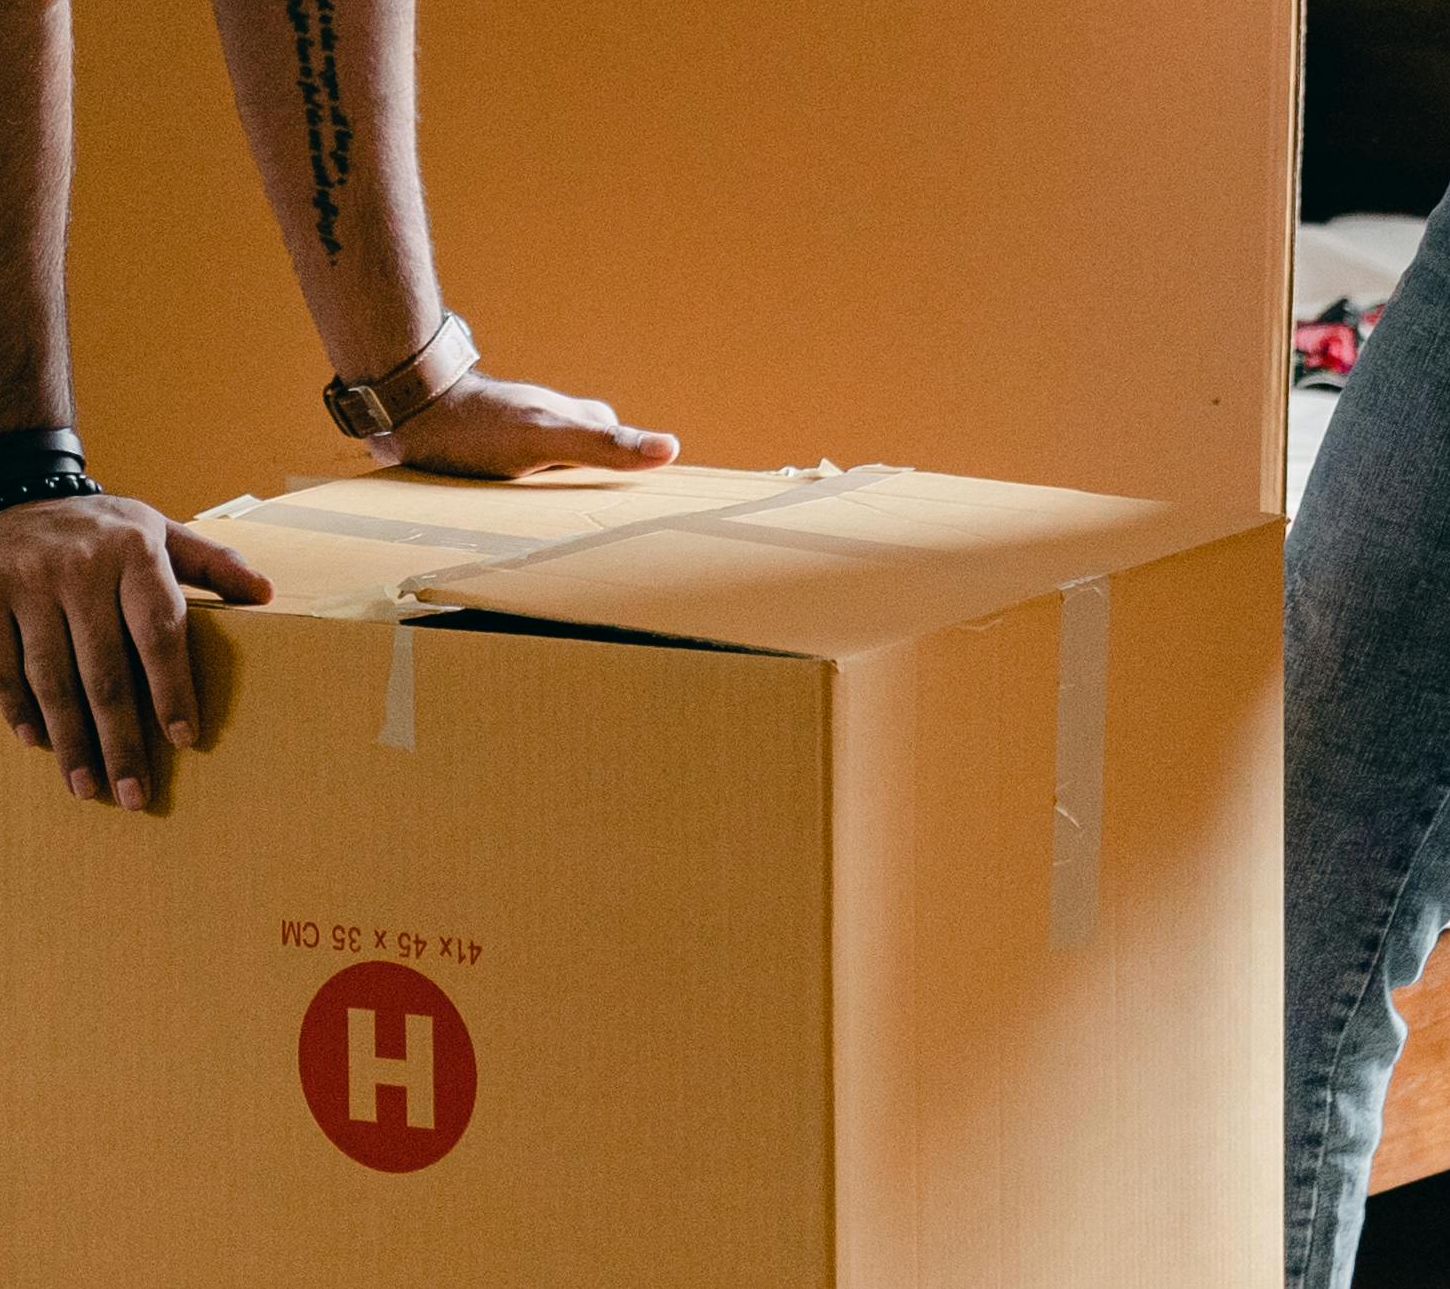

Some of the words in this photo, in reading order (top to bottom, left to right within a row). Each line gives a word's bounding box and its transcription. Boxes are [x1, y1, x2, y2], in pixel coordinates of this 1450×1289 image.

[281, 919, 320, 949] CM
[331, 925, 362, 954] 35
[373, 929, 388, 950] x
[397, 932, 428, 960] 45
[439, 935, 483, 965] 41x
[347, 1007, 436, 1129] H
